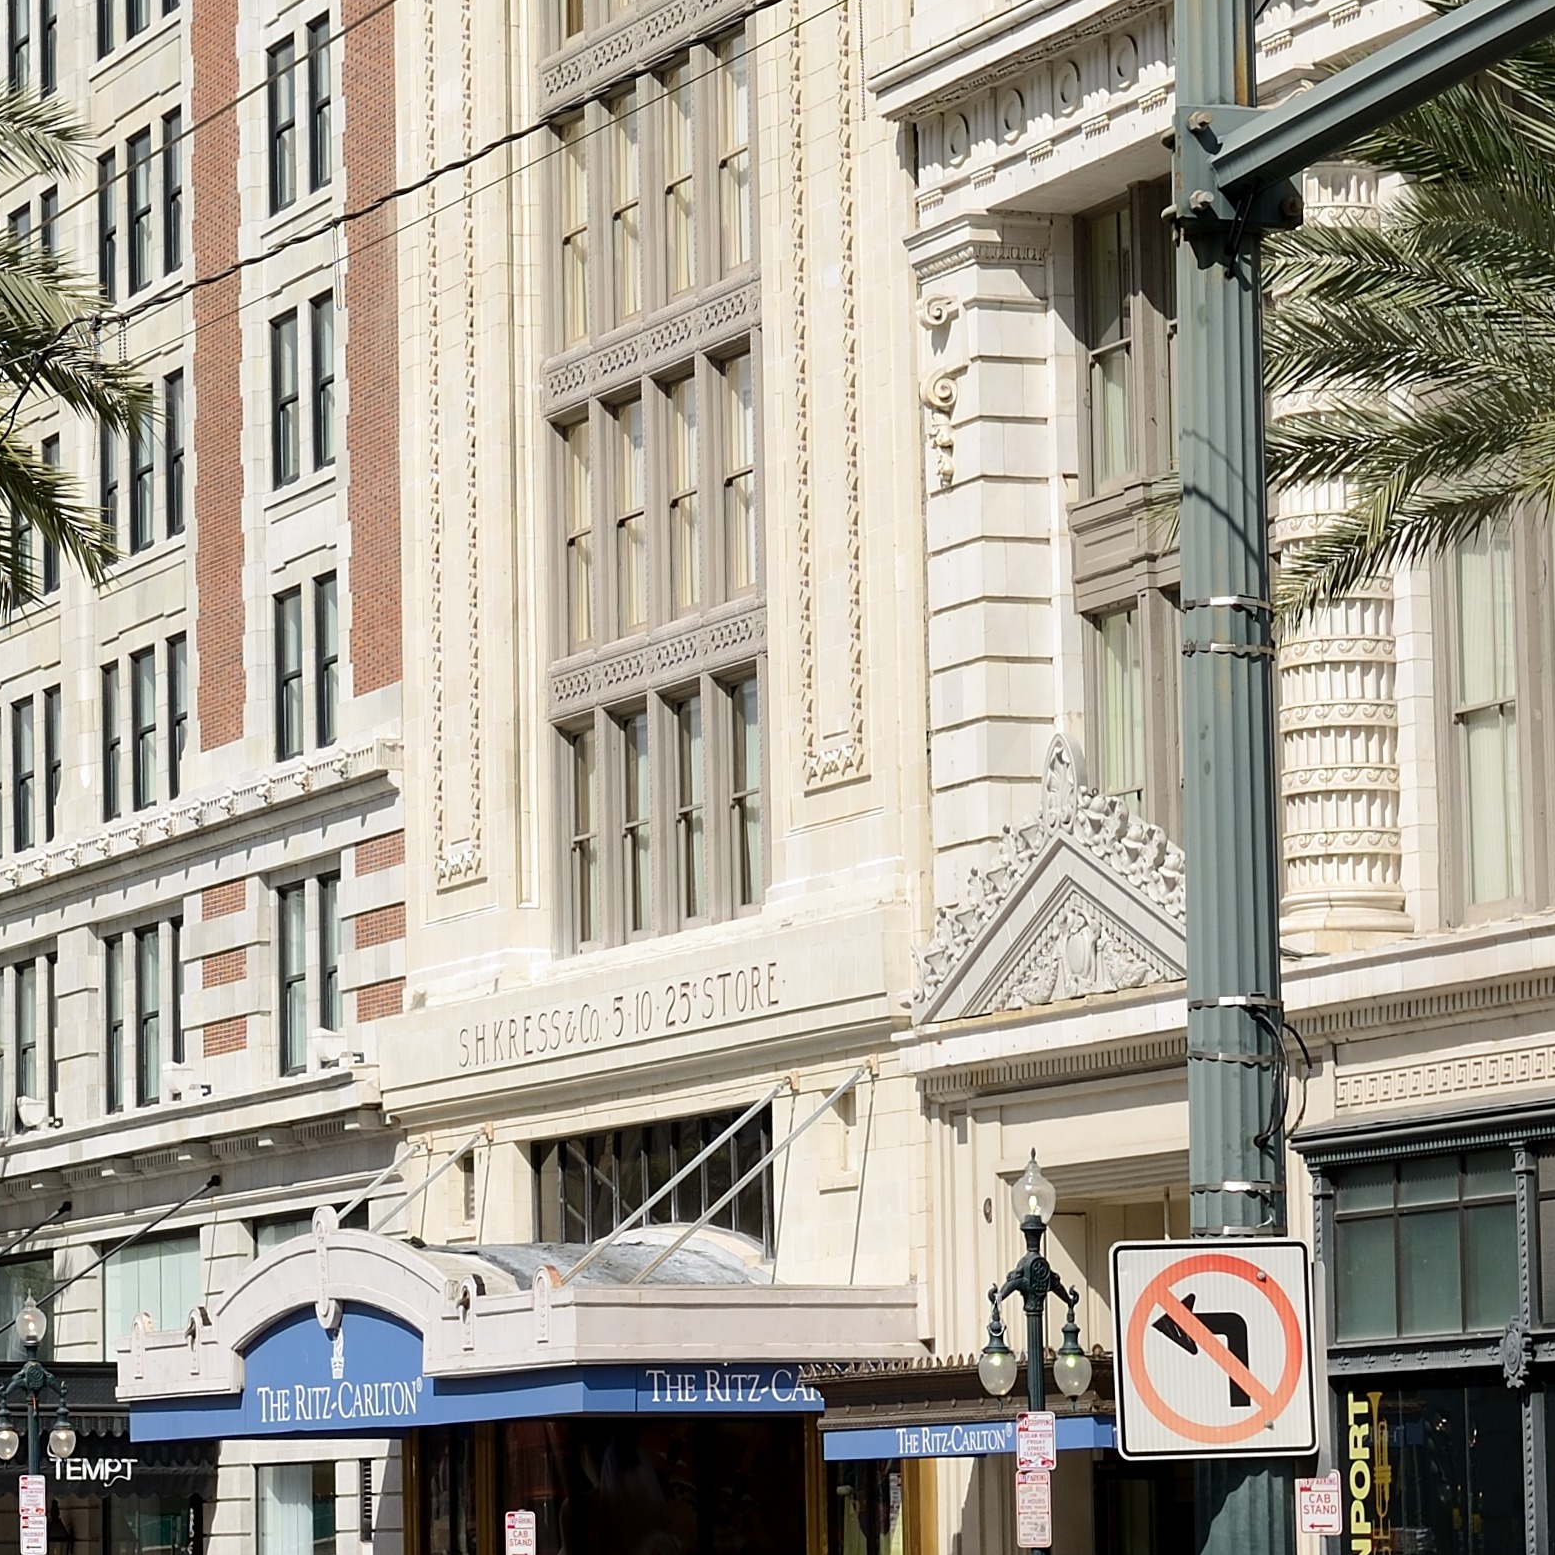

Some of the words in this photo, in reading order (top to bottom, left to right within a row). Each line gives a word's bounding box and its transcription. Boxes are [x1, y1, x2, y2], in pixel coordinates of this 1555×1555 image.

[645, 1369, 698, 1403] THE
[256, 1386, 292, 1423] THE
[896, 1428, 920, 1454] THE
[47, 1452, 139, 1487] TEMPT
[1308, 1493, 1331, 1504] CAB
[1303, 1504, 1337, 1515] STAND
[509, 1538, 533, 1547] STAND
[512, 1530, 529, 1538] CAB
